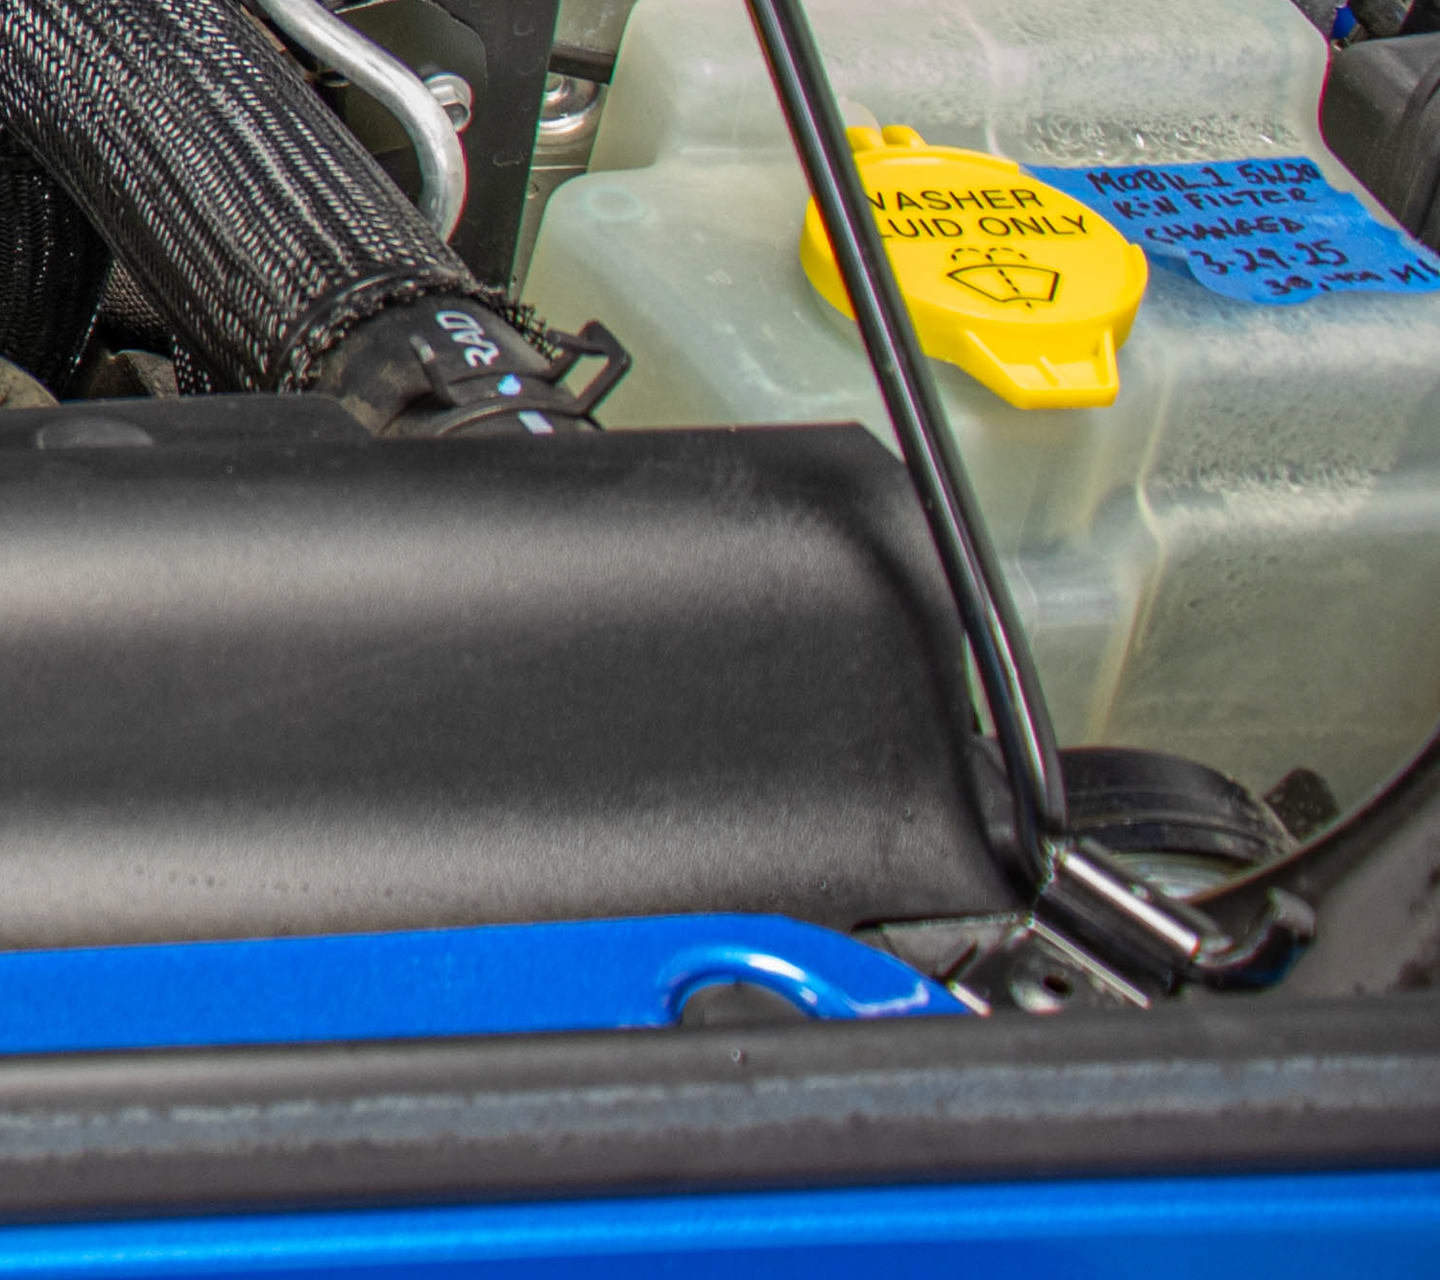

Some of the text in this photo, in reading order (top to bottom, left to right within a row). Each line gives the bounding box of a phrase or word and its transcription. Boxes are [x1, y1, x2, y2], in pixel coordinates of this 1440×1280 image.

[1184, 188, 1317, 212] FILTER
[880, 214, 1088, 238] UID ONLY
[1145, 214, 1306, 245] CHANGED
[435, 309, 501, 368] RAD
